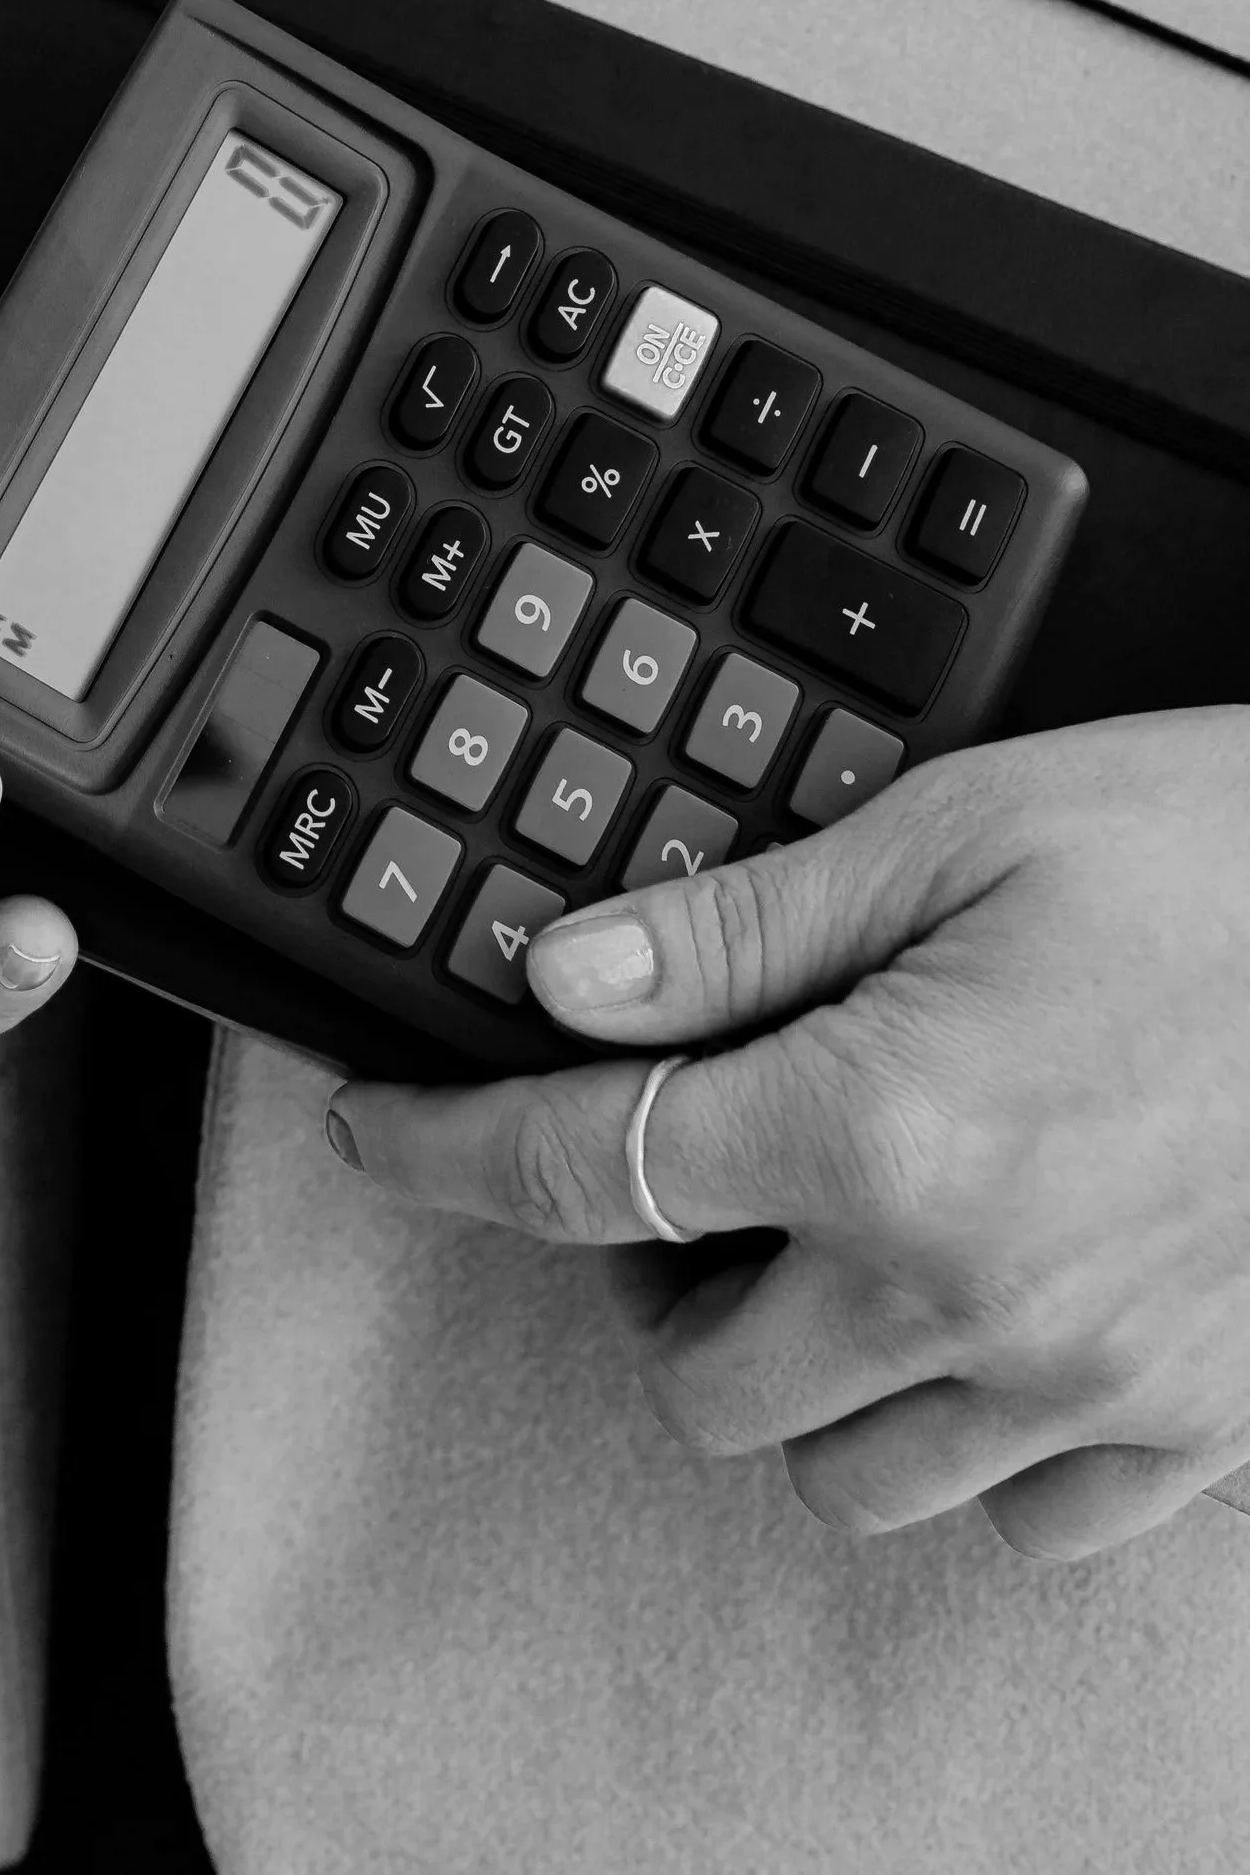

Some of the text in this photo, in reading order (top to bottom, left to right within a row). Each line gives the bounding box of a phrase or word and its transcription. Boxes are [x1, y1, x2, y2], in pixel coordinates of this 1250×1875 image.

[557, 278, 596, 331] AC
[636, 324, 670, 365] ON
[493, 404, 530, 455] GT
[580, 463, 622, 500] %
[346, 491, 391, 551] MU
[422, 539, 466, 593] M+
[514, 594, 552, 632] 9
[1, 621, 37, 658] M
[622, 649, 660, 686] 6
[722, 704, 764, 743] 3
[448, 728, 490, 768] 8
[551, 778, 594, 822] 5
[279, 788, 337, 871] MRC
[661, 839, 705, 877] 2
[378, 860, 420, 903] 7
[491, 920, 530, 962] 4
